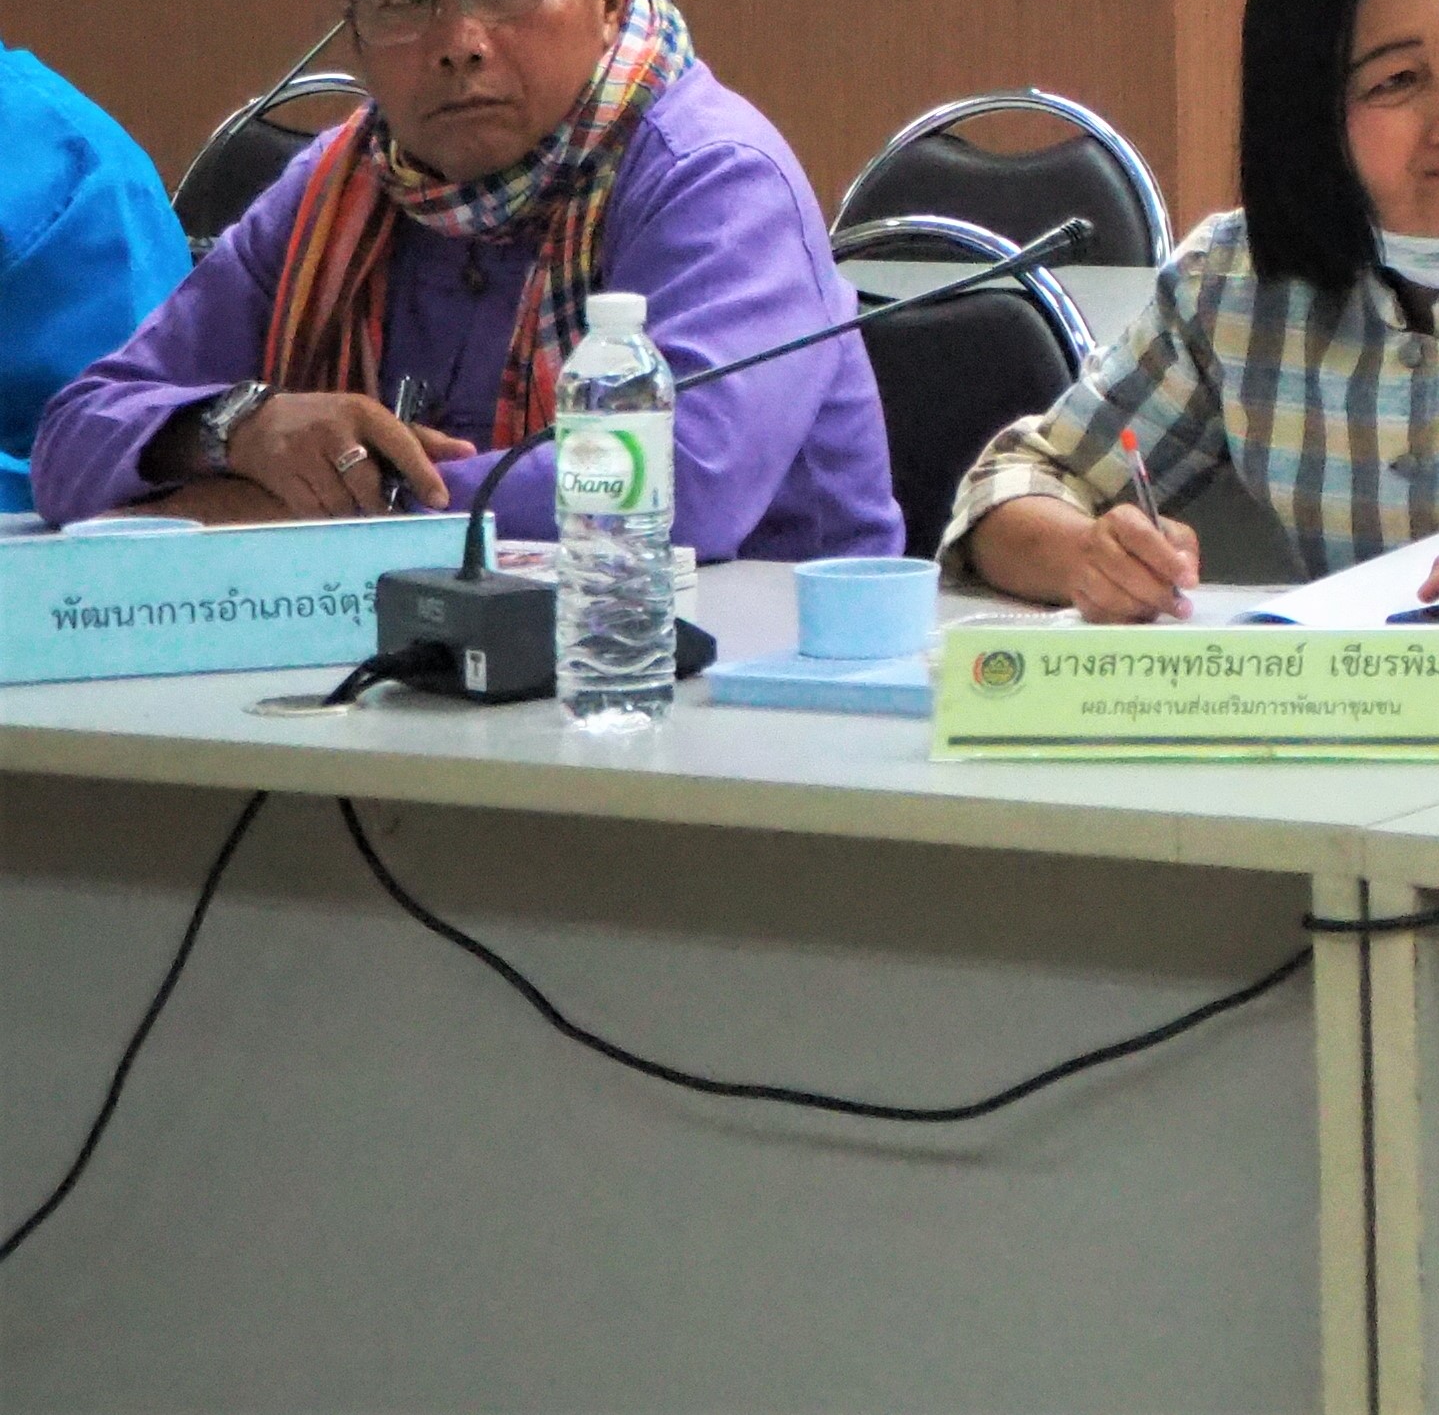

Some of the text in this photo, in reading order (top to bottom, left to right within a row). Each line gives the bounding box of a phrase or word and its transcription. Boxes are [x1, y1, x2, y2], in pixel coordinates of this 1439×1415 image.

[562, 471, 623, 498] Chang
[1041, 642, 1306, 688] นางสาวพุทธิมาลย์
[1081, 694, 1402, 722] ผอ.กลุ่มงานส่งเสริมการพัฒนาชุมชน
